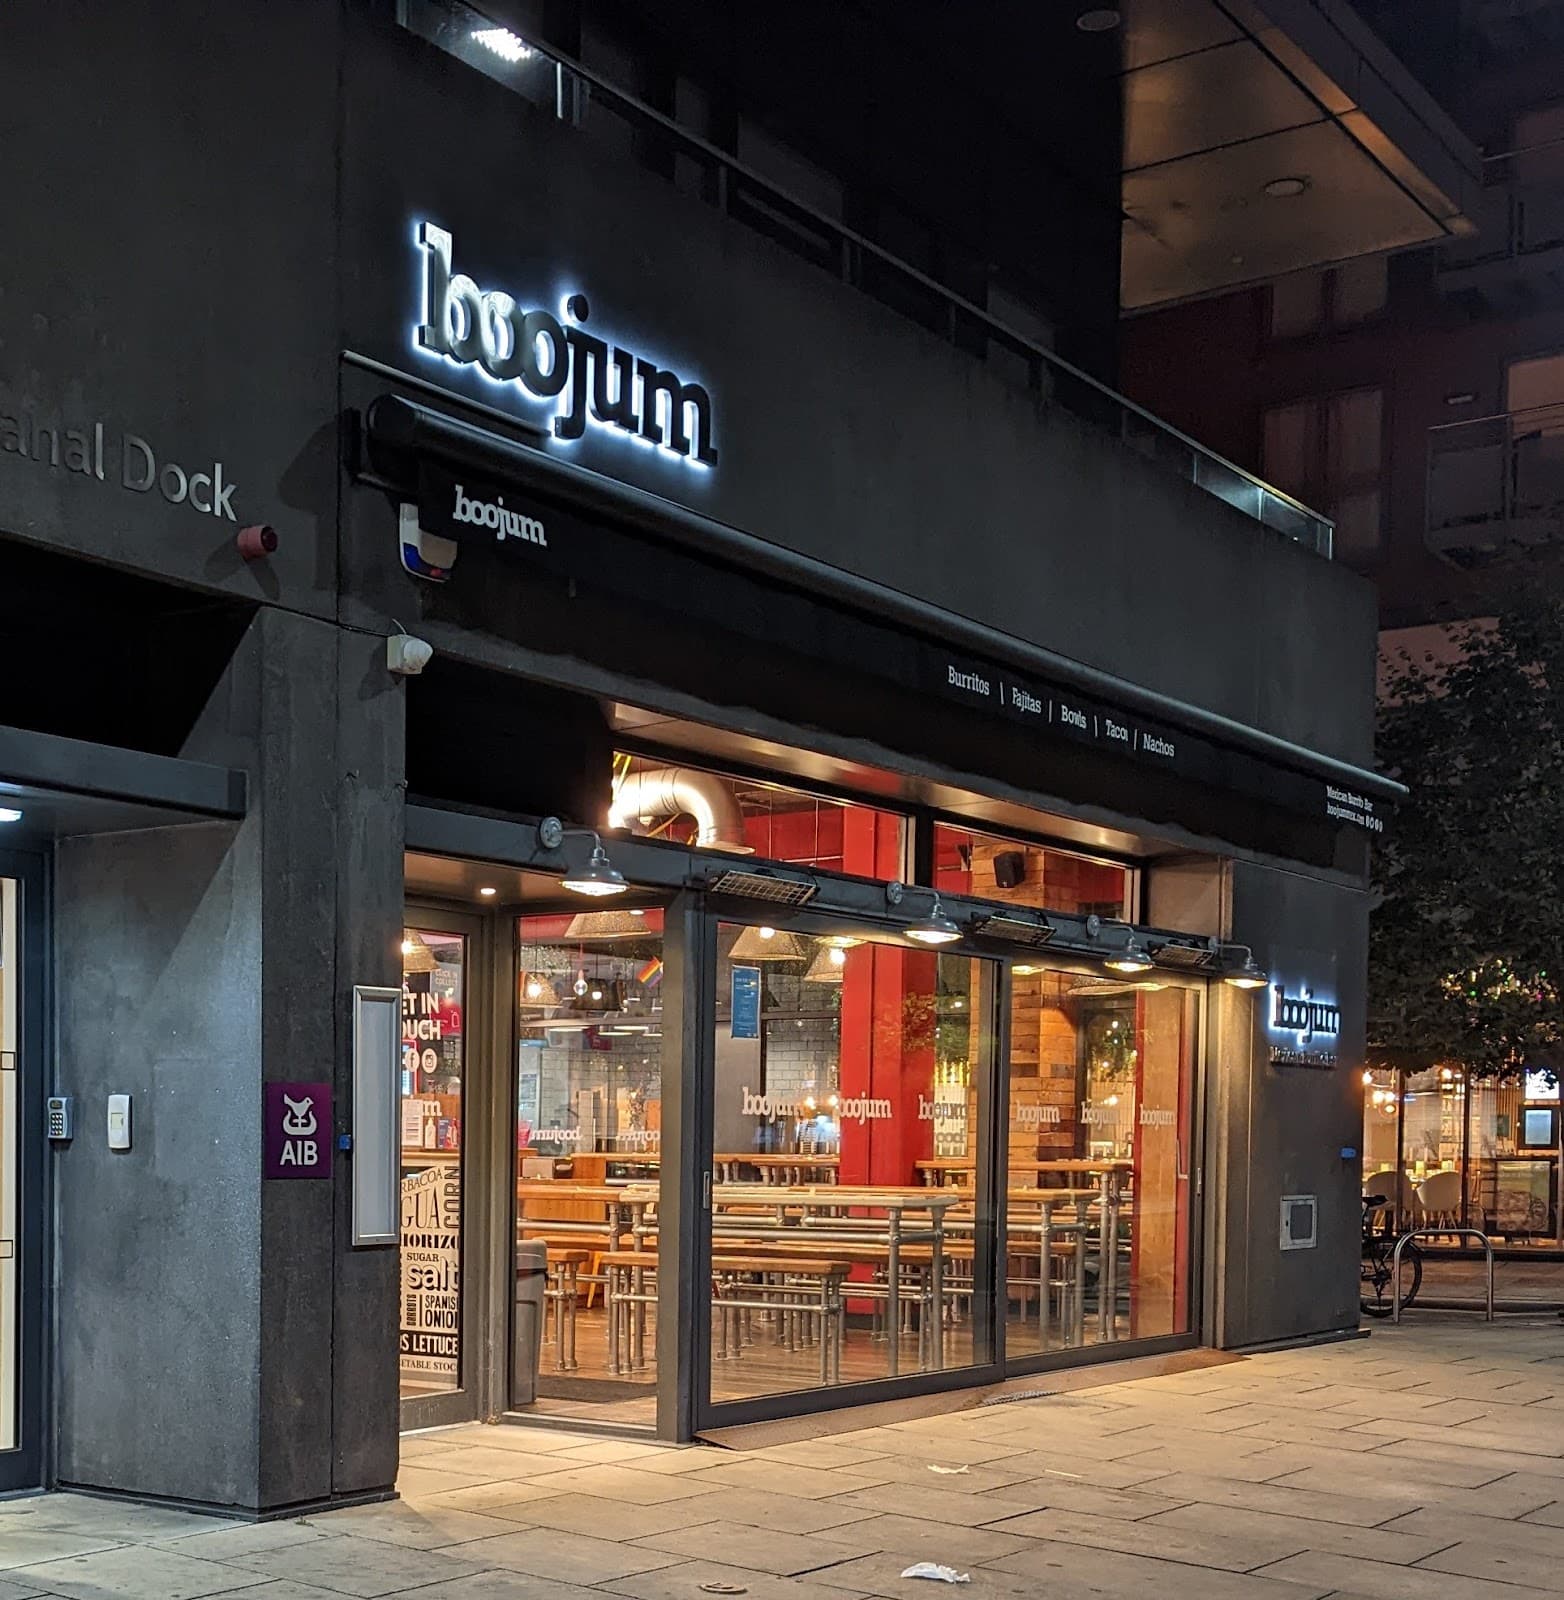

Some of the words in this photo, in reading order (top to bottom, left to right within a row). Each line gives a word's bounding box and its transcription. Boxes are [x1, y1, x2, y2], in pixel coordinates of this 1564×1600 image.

[418, 221, 718, 466] boojum
[121, 432, 237, 522] Dock
[453, 484, 547, 546] boojum
[948, 665, 990, 696] Burritos
[1012, 687, 1042, 714] Fajitas
[1061, 704, 1087, 729] Bowls
[1105, 719, 1129, 741] Taco
[1143, 733, 1175, 757] Nachos
[421, 992, 441, 1015] IN
[1272, 985, 1341, 1043] boojum
[280, 1140, 318, 1166] AIB
[444, 1165, 460, 1229] CORN
[406, 1252, 440, 1262] SUGAR
[406, 1255, 459, 1292] salt
[413, 1334, 458, 1355] LETTUCE
